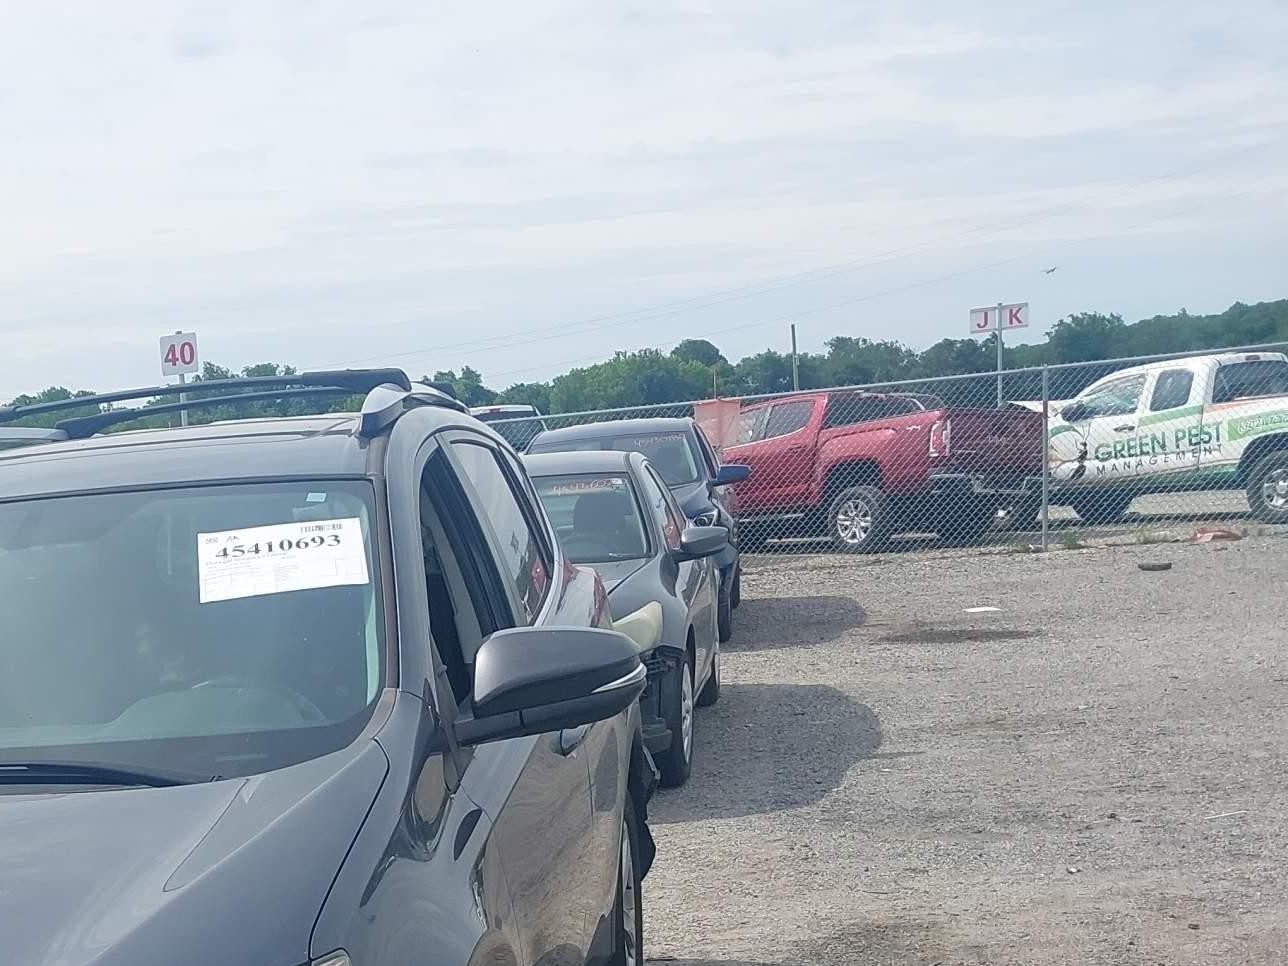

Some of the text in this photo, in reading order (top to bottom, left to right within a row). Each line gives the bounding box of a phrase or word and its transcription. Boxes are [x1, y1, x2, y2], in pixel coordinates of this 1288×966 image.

[977, 311, 989, 328] J
[1008, 307, 1023, 325] K
[164, 341, 195, 366] 40
[1094, 431, 1166, 462] GREEN
[1174, 421, 1223, 449] PEST
[1096, 444, 1223, 476] MANAGEMENT
[215, 534, 342, 559] 45410693
